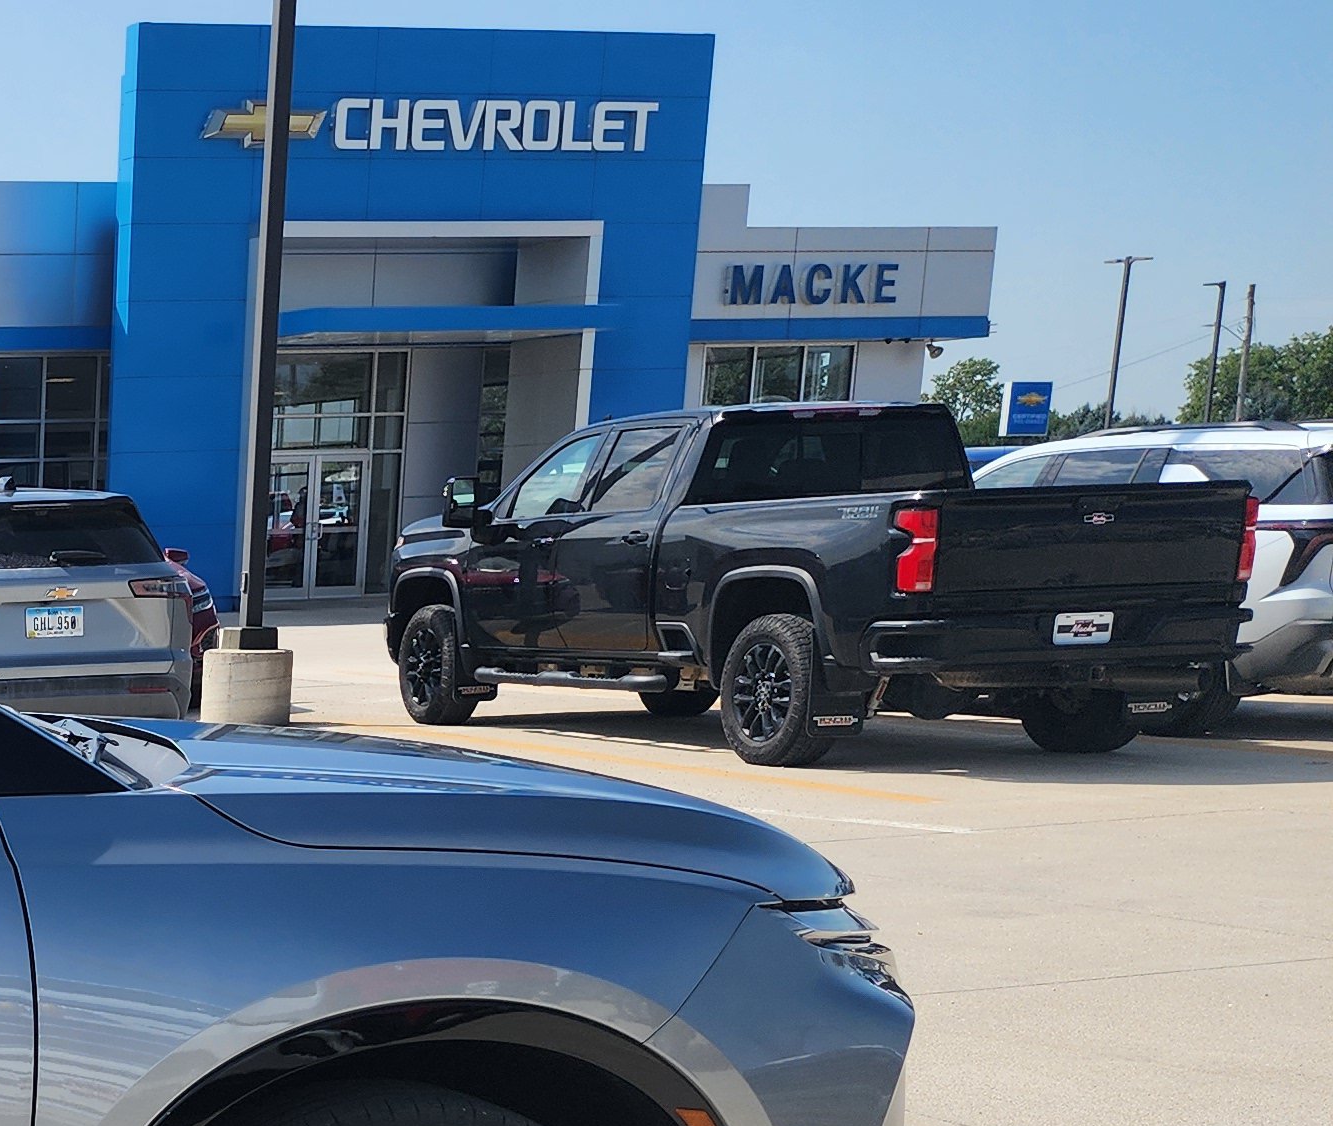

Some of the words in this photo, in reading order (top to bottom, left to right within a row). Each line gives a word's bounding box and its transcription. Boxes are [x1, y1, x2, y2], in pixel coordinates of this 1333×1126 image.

[335, 98, 660, 152] CHEVROLET
[728, 263, 900, 305] MACKE
[33, 616, 54, 631] GHL
[57, 615, 77, 630] 950
